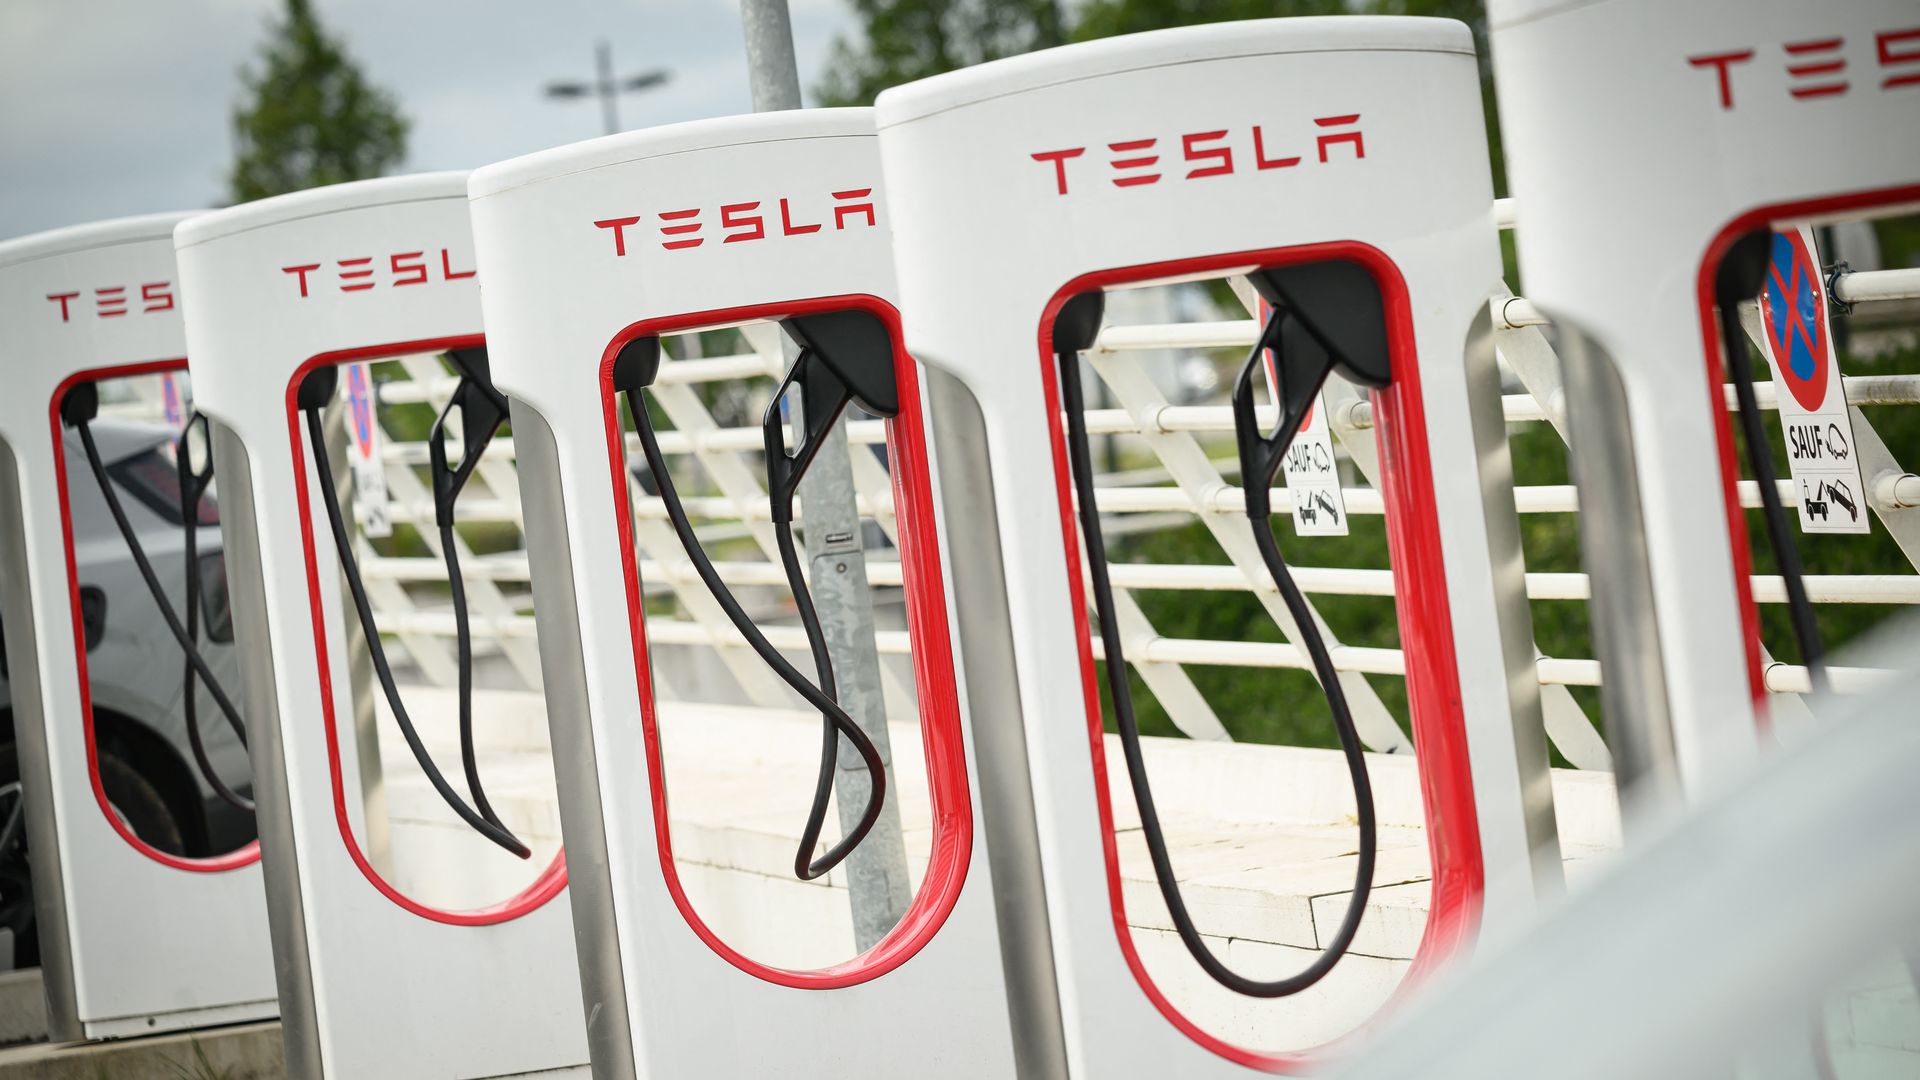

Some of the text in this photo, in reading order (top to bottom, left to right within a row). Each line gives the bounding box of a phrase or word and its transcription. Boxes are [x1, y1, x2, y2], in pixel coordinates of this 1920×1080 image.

[1687, 27, 1920, 109] TES
[1031, 113, 1365, 196] TESLA
[594, 187, 877, 257] TESLA
[282, 248, 477, 299] TESL
[47, 281, 174, 321] TES
[1286, 443, 1312, 473] SAUF
[1789, 424, 1823, 459] SAUF
